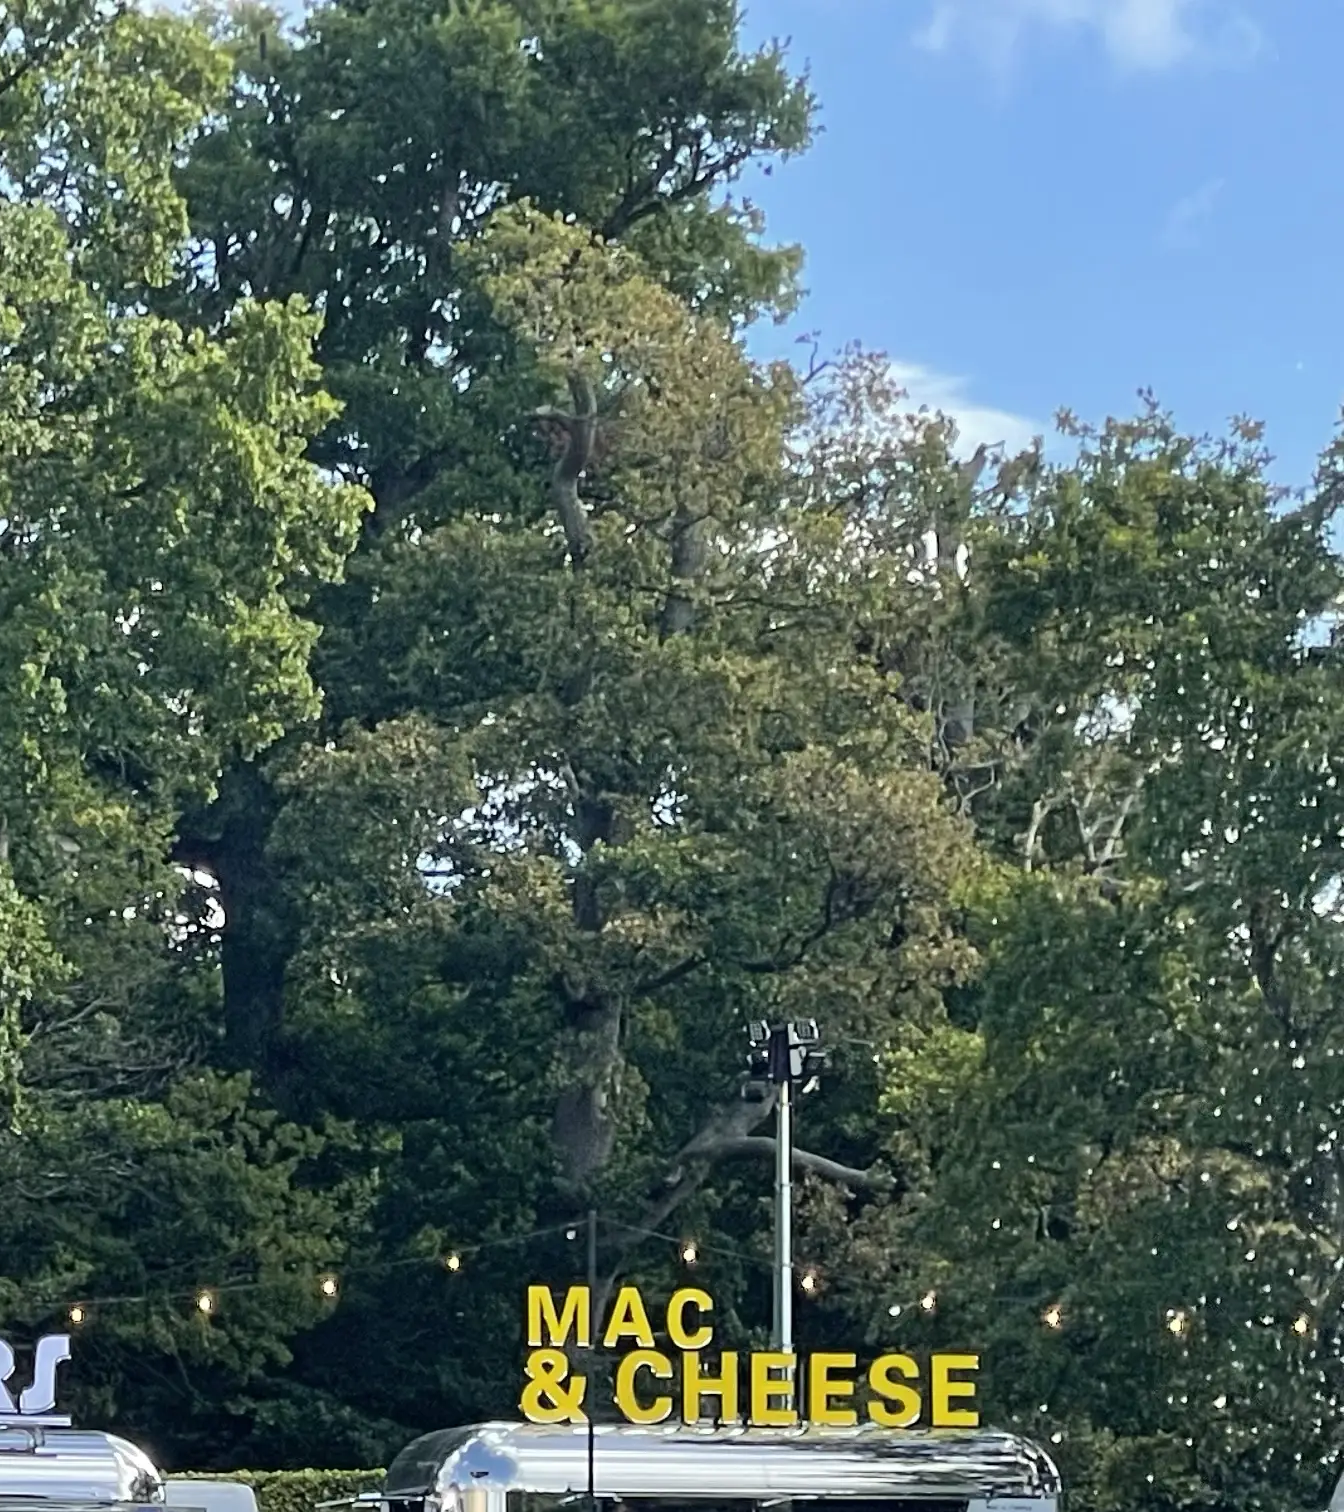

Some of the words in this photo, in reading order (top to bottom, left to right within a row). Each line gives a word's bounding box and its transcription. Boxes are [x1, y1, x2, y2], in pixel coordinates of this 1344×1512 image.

[526, 1285, 714, 1349] MAC
[519, 1349, 590, 1424] &
[613, 1350, 981, 1428] CHEESE
